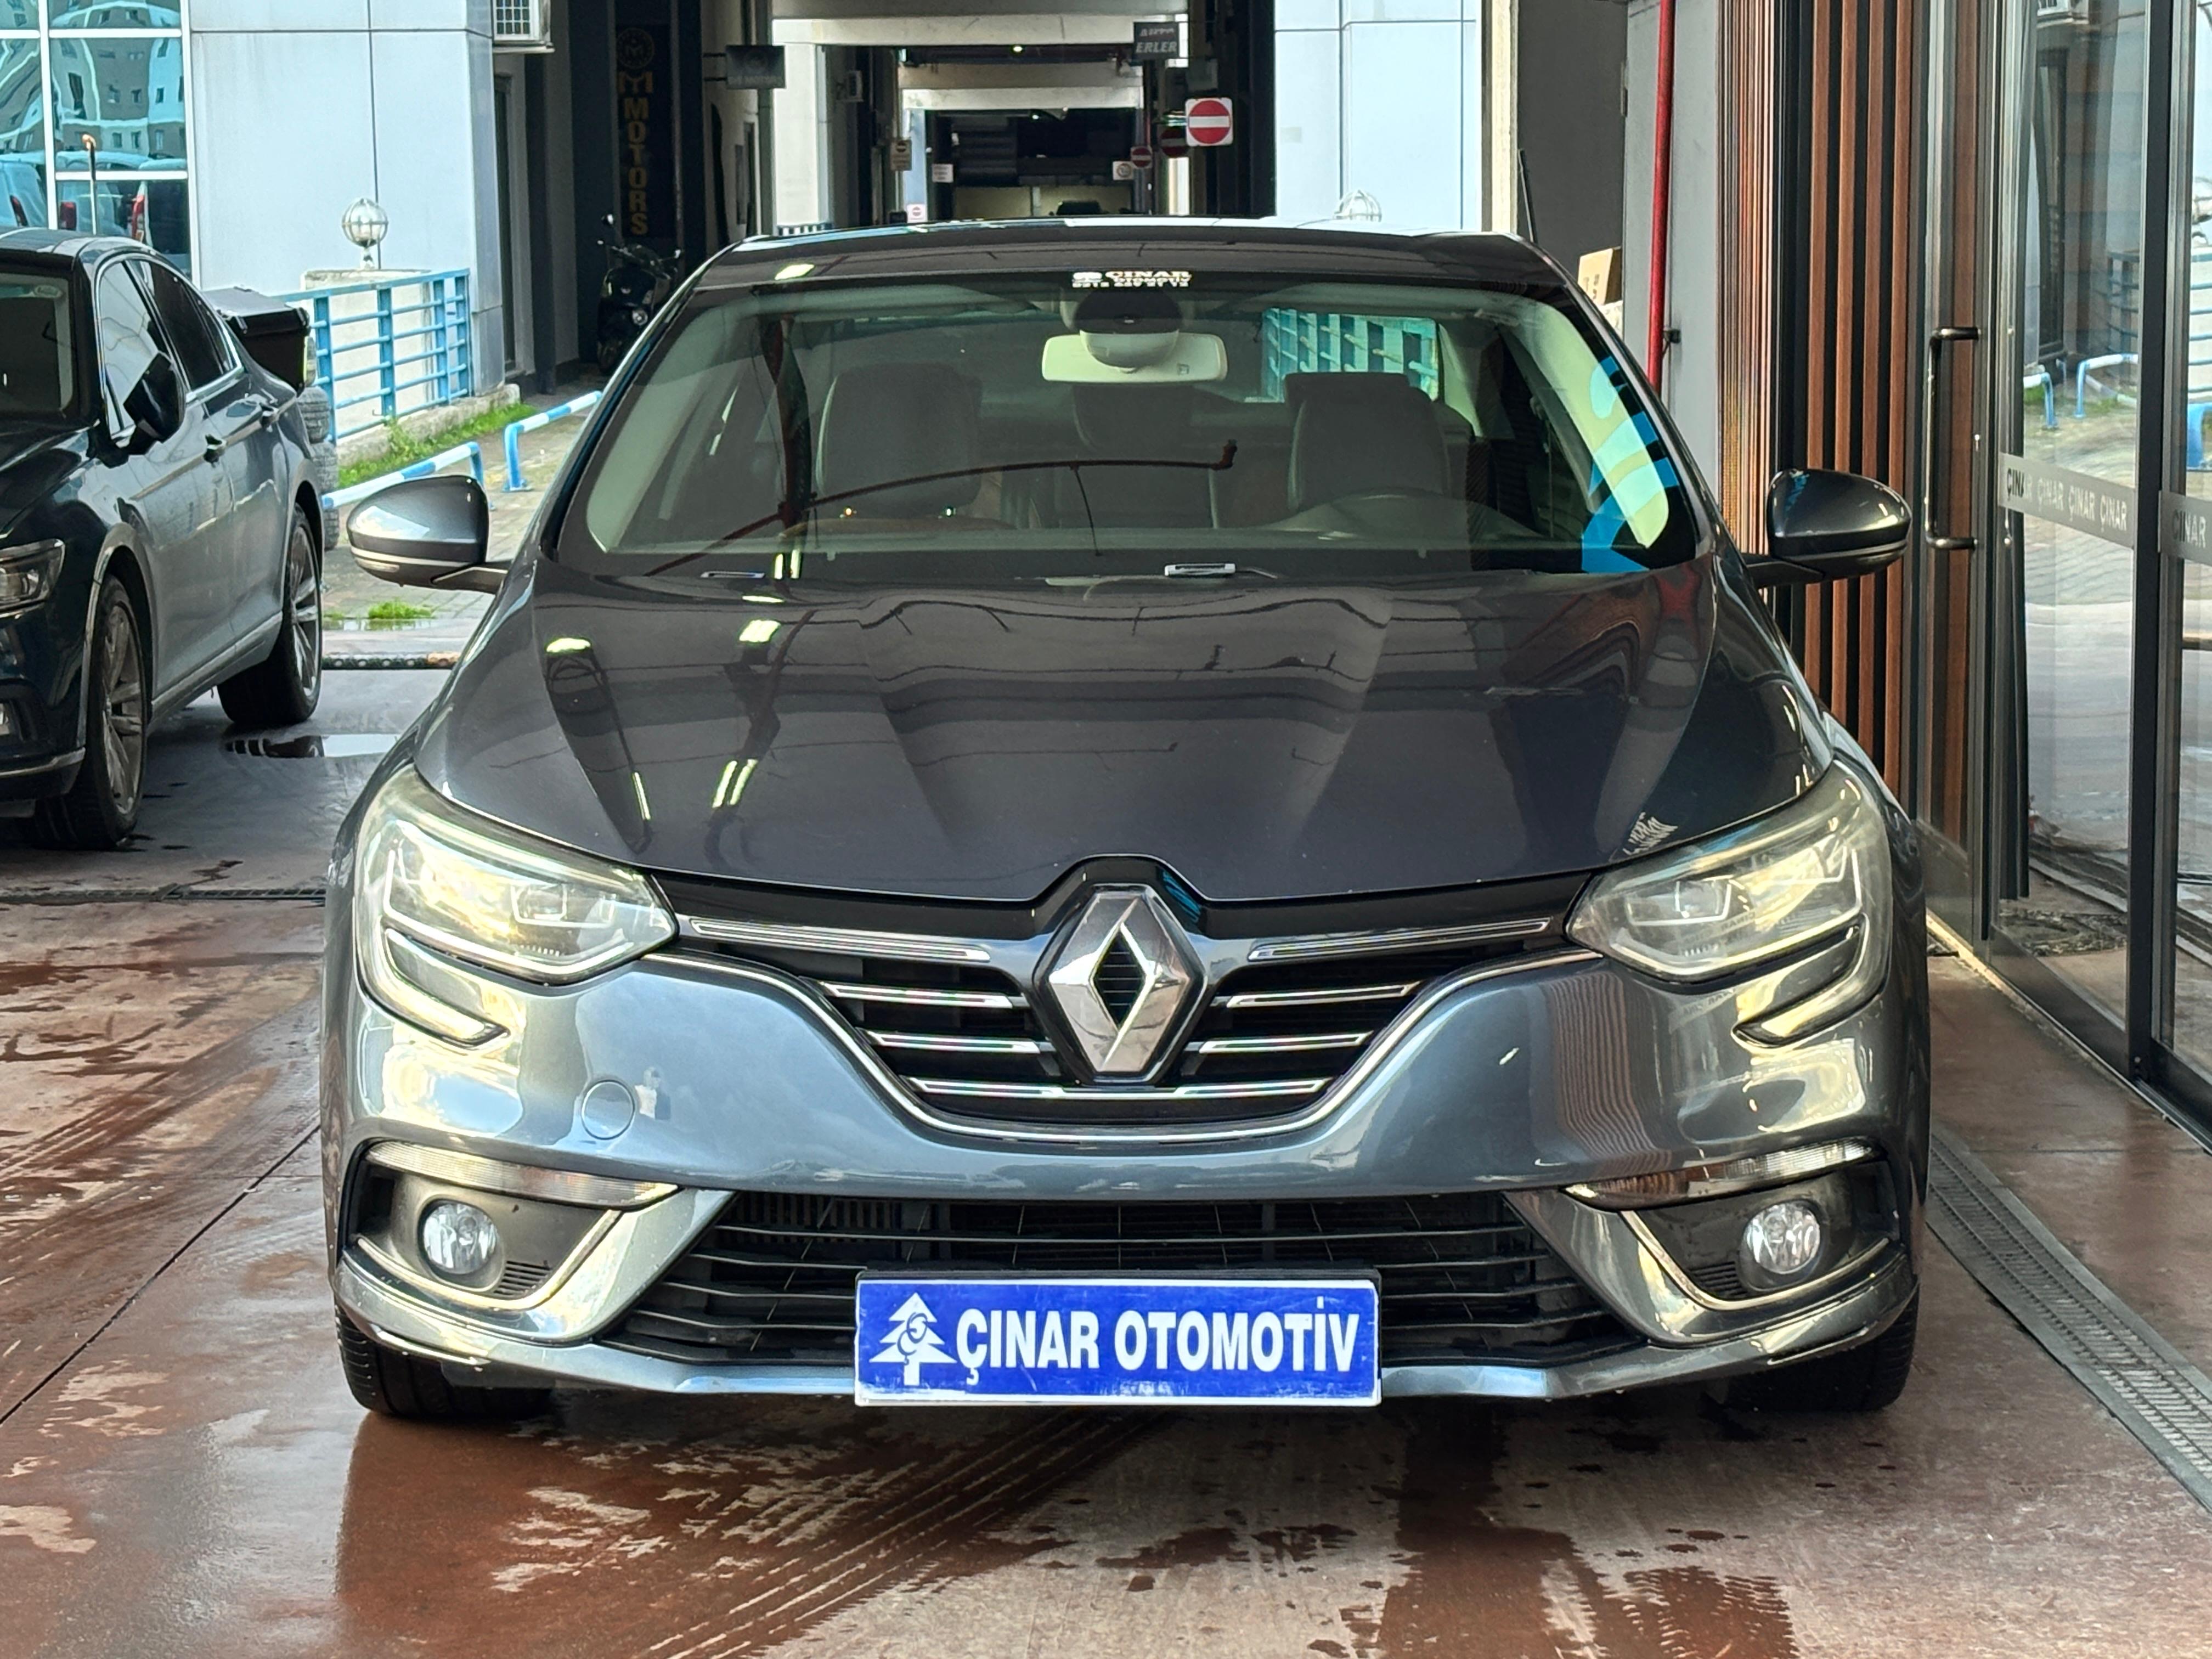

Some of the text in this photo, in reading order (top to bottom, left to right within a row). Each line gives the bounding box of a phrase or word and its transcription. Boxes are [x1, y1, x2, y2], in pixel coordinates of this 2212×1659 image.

[624, 97, 649, 235] MOTORS
[2068, 485, 2095, 521] ÇINAR
[2100, 495, 2128, 533] ÇINAR
[957, 1296, 1359, 1385] ÇINAR OTOMOTİV
